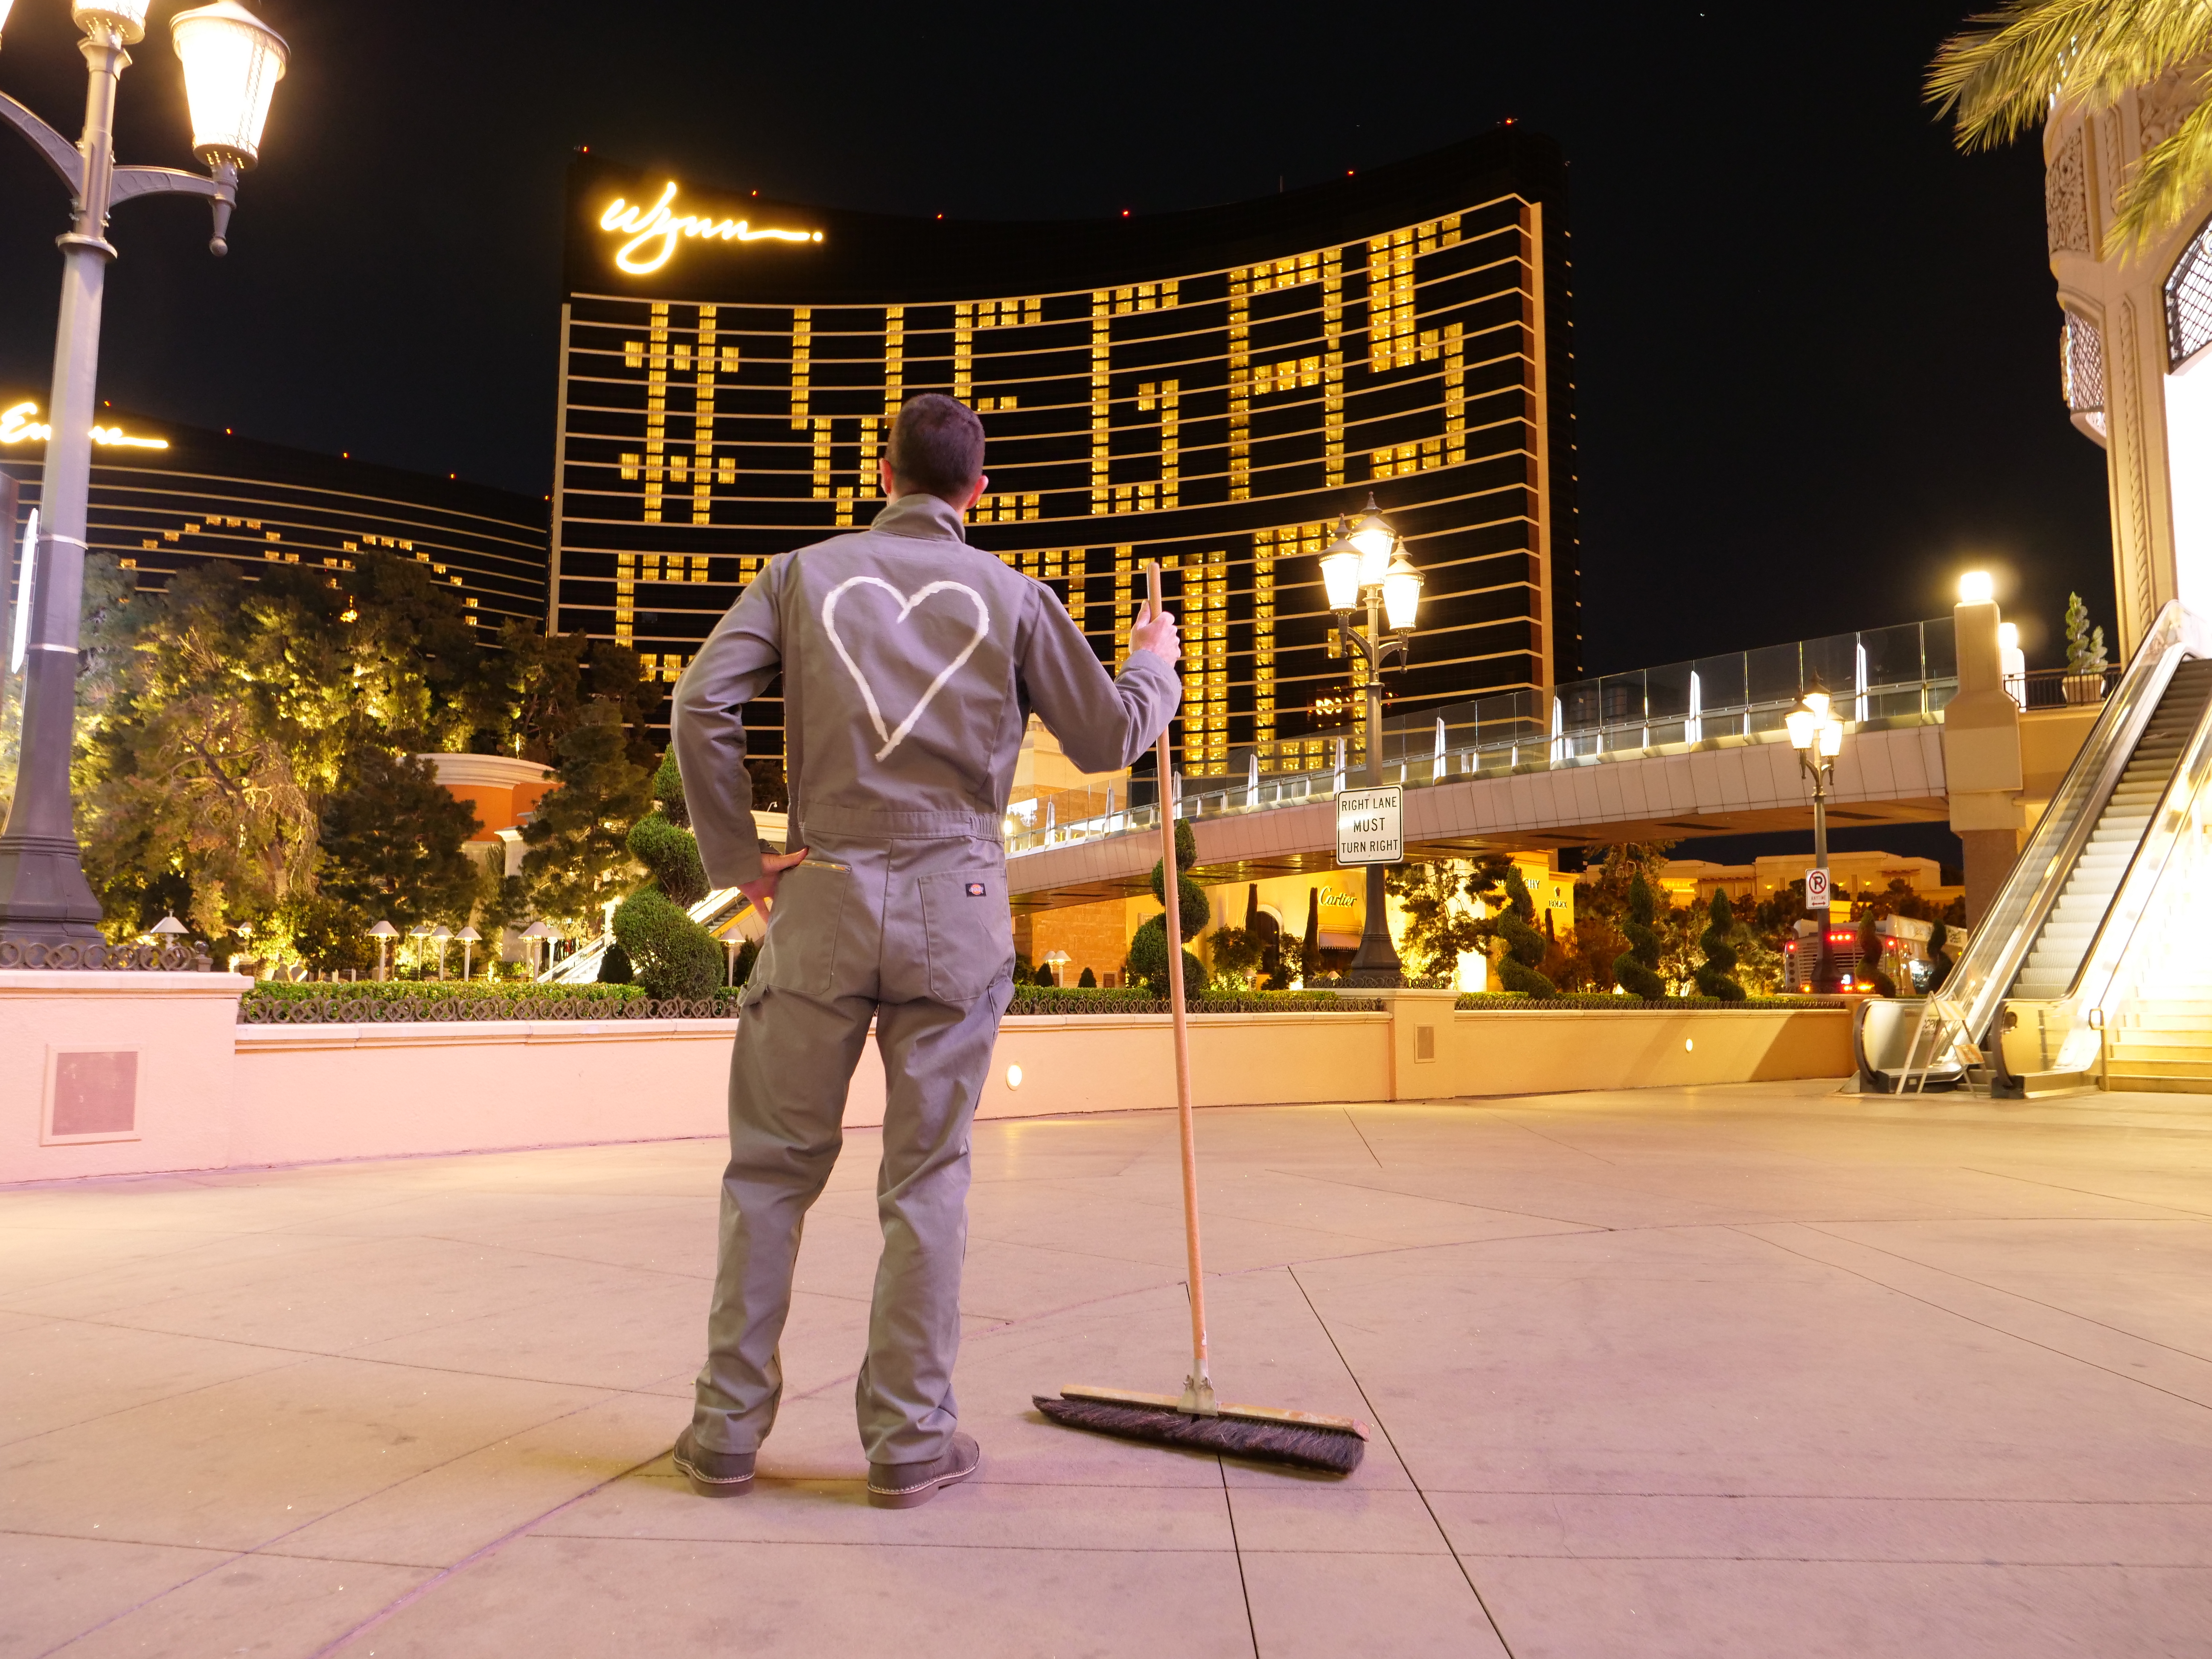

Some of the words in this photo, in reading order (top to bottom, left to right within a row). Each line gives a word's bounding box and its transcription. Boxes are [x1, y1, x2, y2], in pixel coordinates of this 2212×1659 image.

[1342, 799, 1369, 811] RIGHT
[1373, 797, 1397, 809] LANE
[1353, 818, 1385, 832] MUST
[1342, 841, 1366, 853] TURN
[1370, 839, 1398, 851] RIGHT
[1319, 886, 1357, 908] Cartier
[1549, 900, 1567, 908] ROLEX
